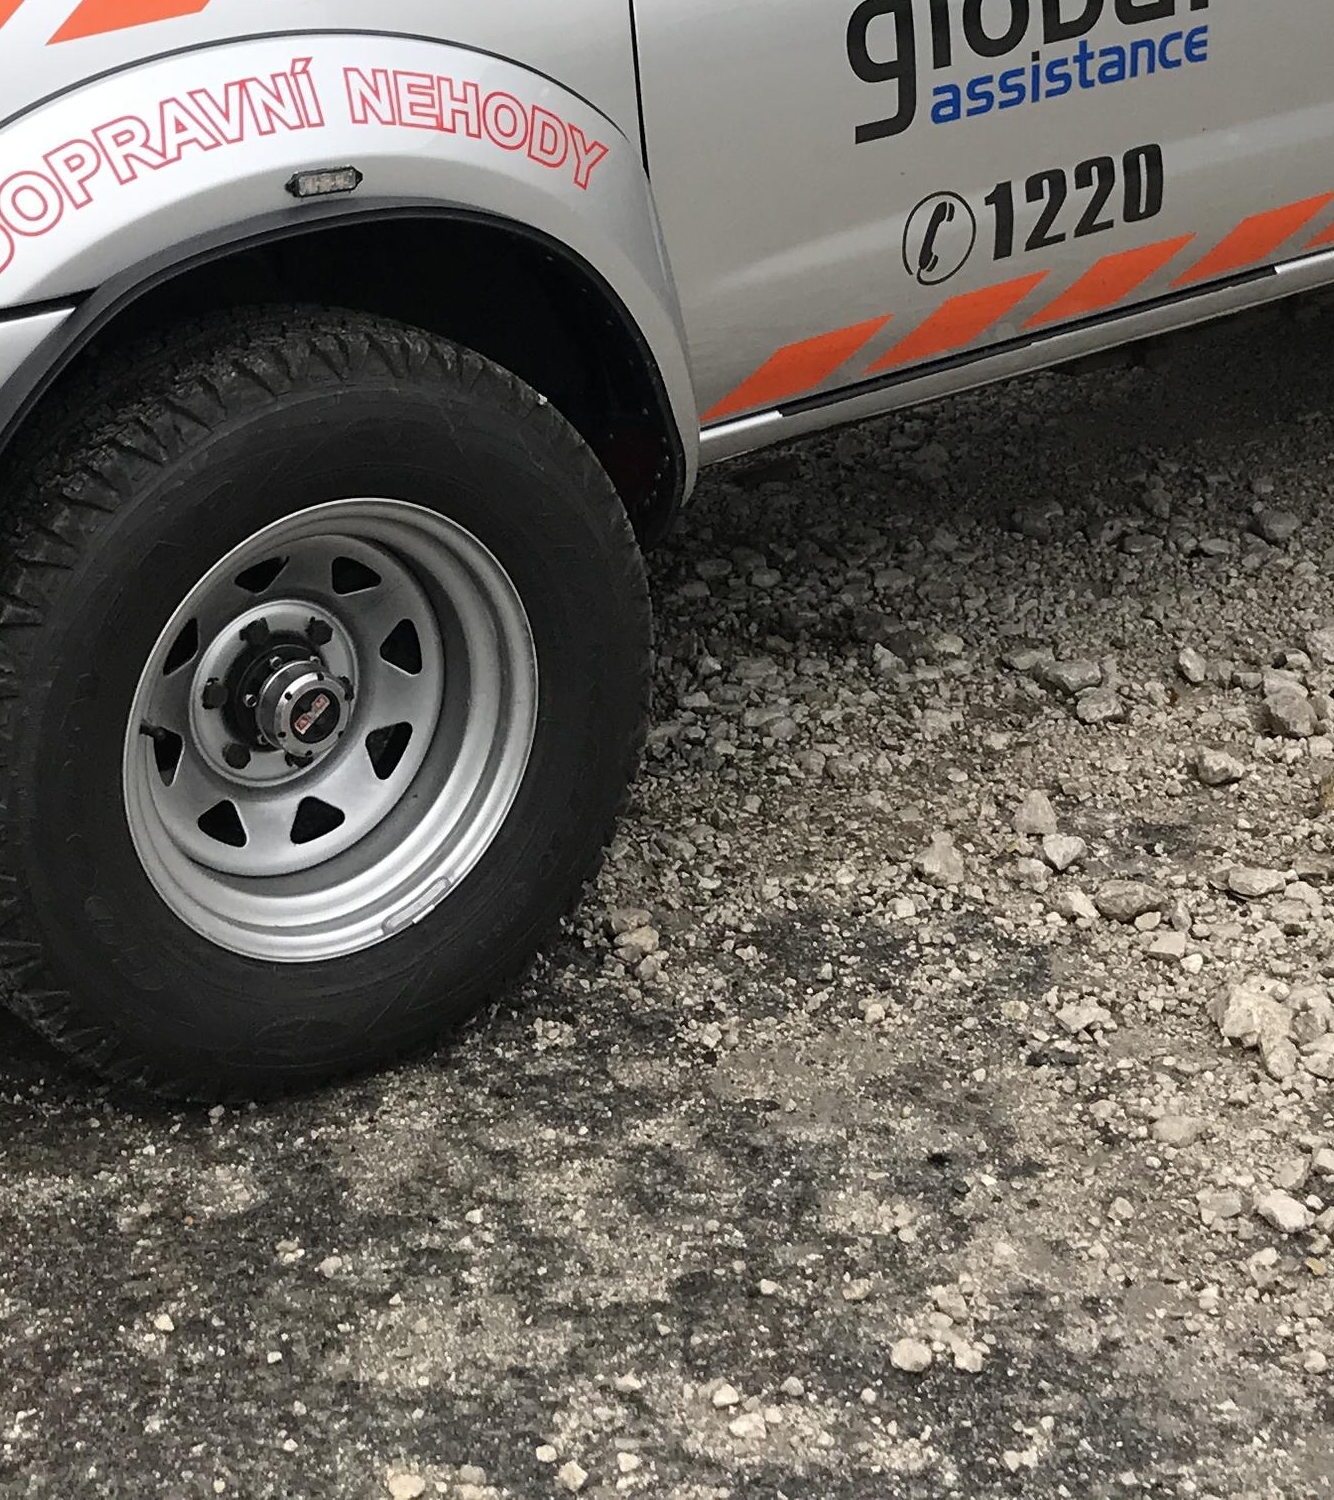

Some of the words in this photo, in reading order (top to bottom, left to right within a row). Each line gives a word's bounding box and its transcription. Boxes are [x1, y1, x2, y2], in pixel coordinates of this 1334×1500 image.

[344, 68, 610, 190] NEHODY
[930, 25, 1208, 124] assistance
[984, 143, 1164, 260] 1220
